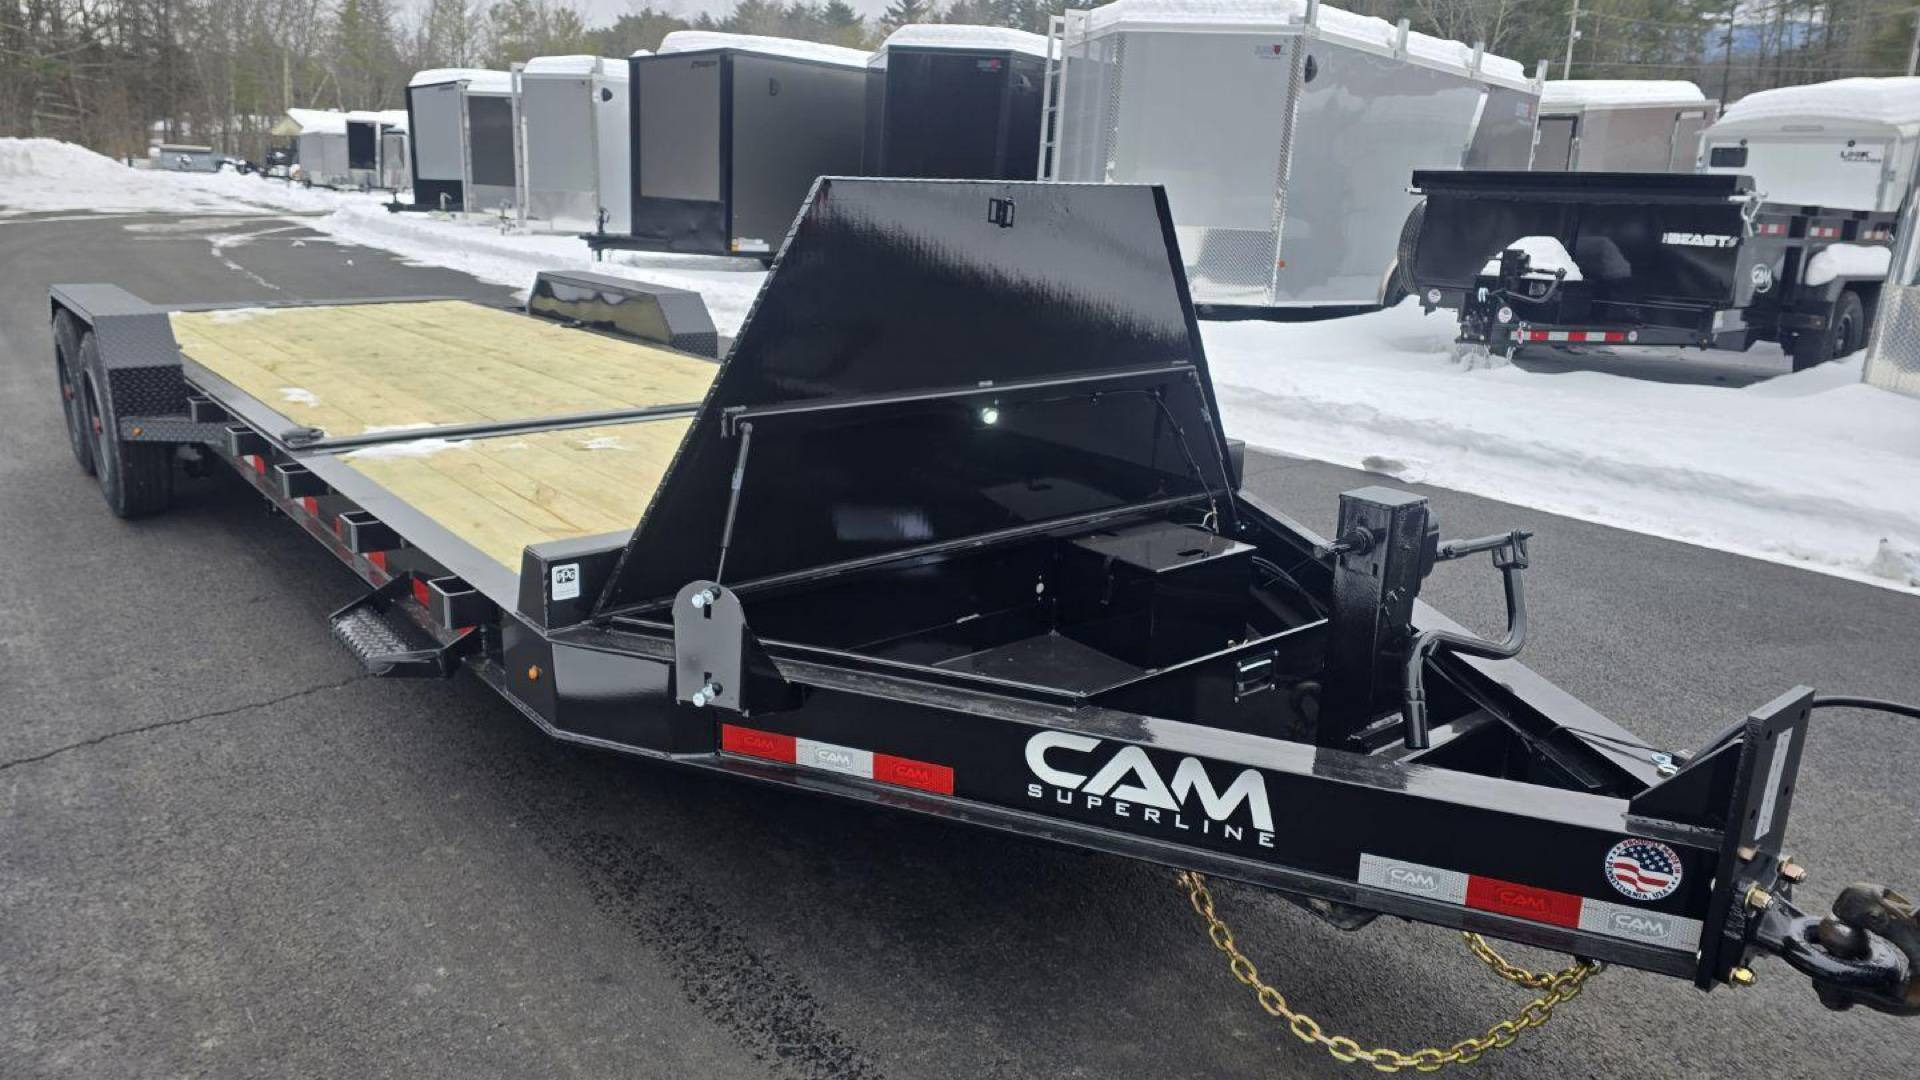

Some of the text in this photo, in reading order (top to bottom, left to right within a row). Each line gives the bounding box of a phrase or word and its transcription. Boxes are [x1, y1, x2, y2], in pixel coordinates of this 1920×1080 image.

[1667, 231, 1731, 248] BEAST
[816, 750, 851, 766] CAM
[1025, 731, 1275, 832] CAM
[1027, 783, 1275, 848] SUPERLINE
[1390, 869, 1436, 888] CAM
[1615, 914, 1664, 935] CAM
